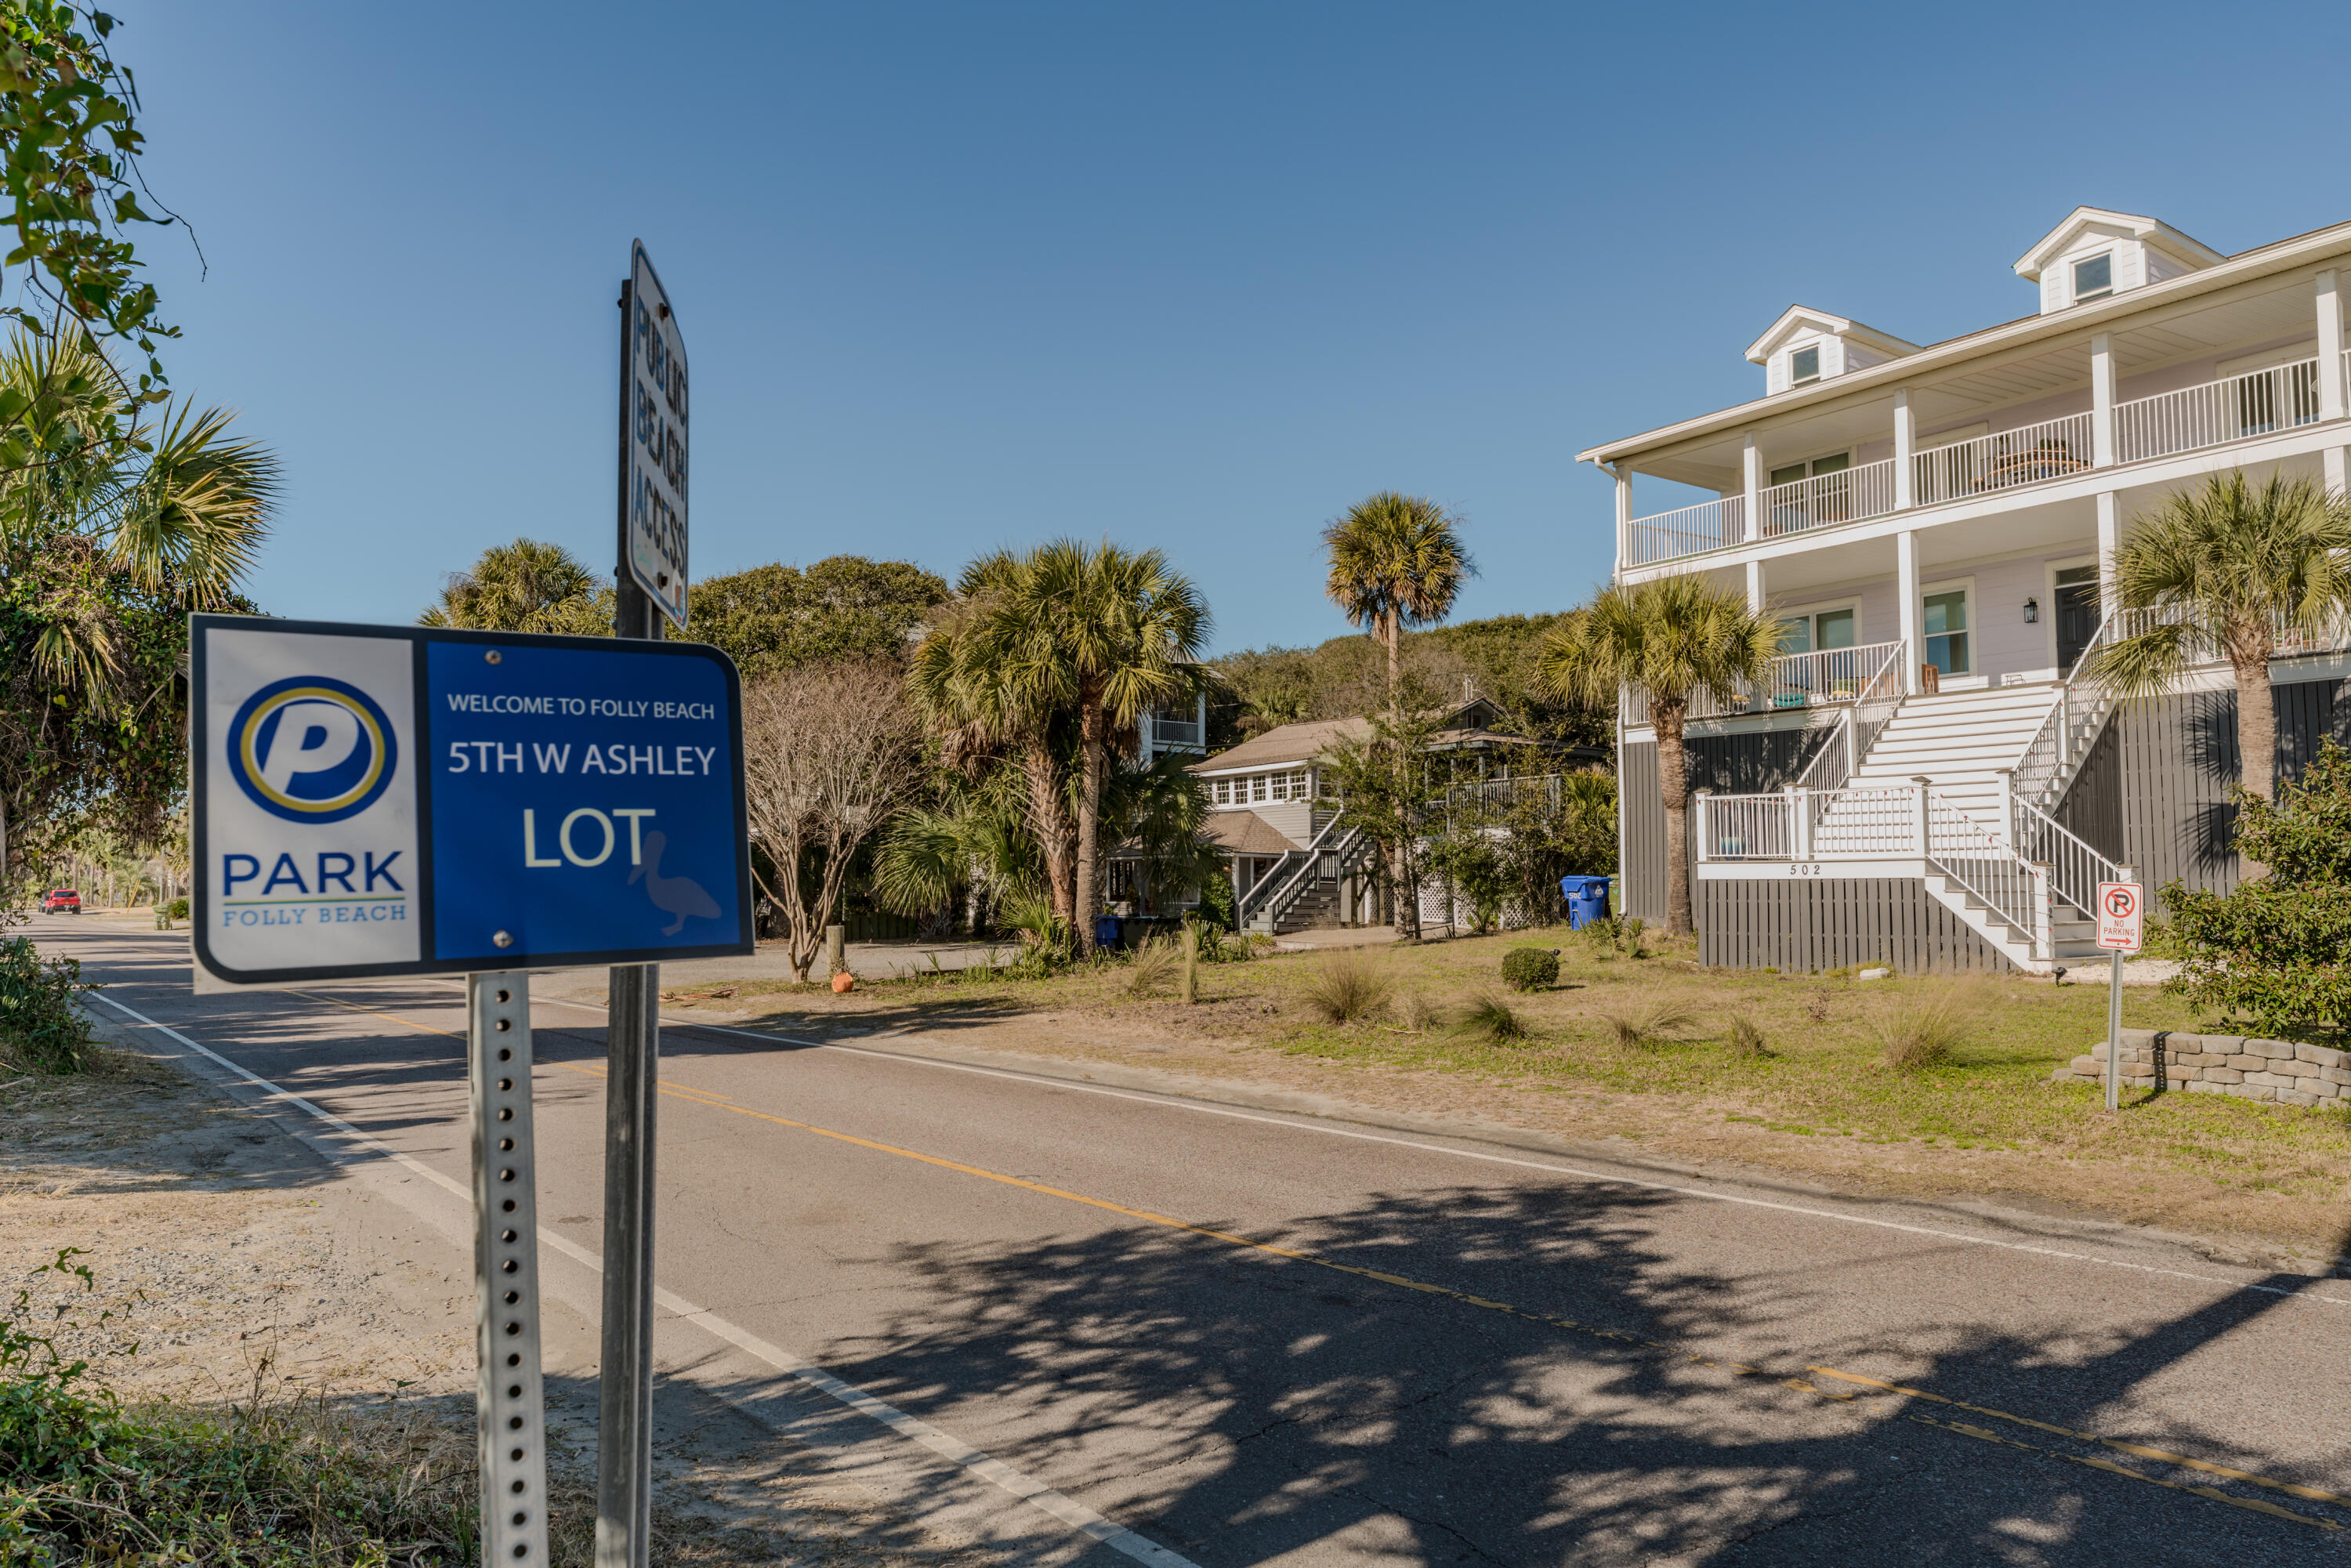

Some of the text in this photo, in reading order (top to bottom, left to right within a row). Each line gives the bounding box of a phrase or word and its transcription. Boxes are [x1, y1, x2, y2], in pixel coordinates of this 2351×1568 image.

[637, 295, 686, 428] PUBLIC
[636, 377, 685, 502] BEACH
[635, 464, 686, 579] ACCESS
[447, 693, 715, 719] WELCOME TO FOLLY BEACH
[448, 741, 716, 776] 5TH W ASHLEY
[524, 808, 656, 868] LOT
[223, 850, 405, 896] PARK
[1790, 864, 1820, 875] 502
[223, 904, 407, 928] FOLLY BEACH
[2103, 927, 2135, 936] PARKING
[2114, 919, 2125, 928] NO
